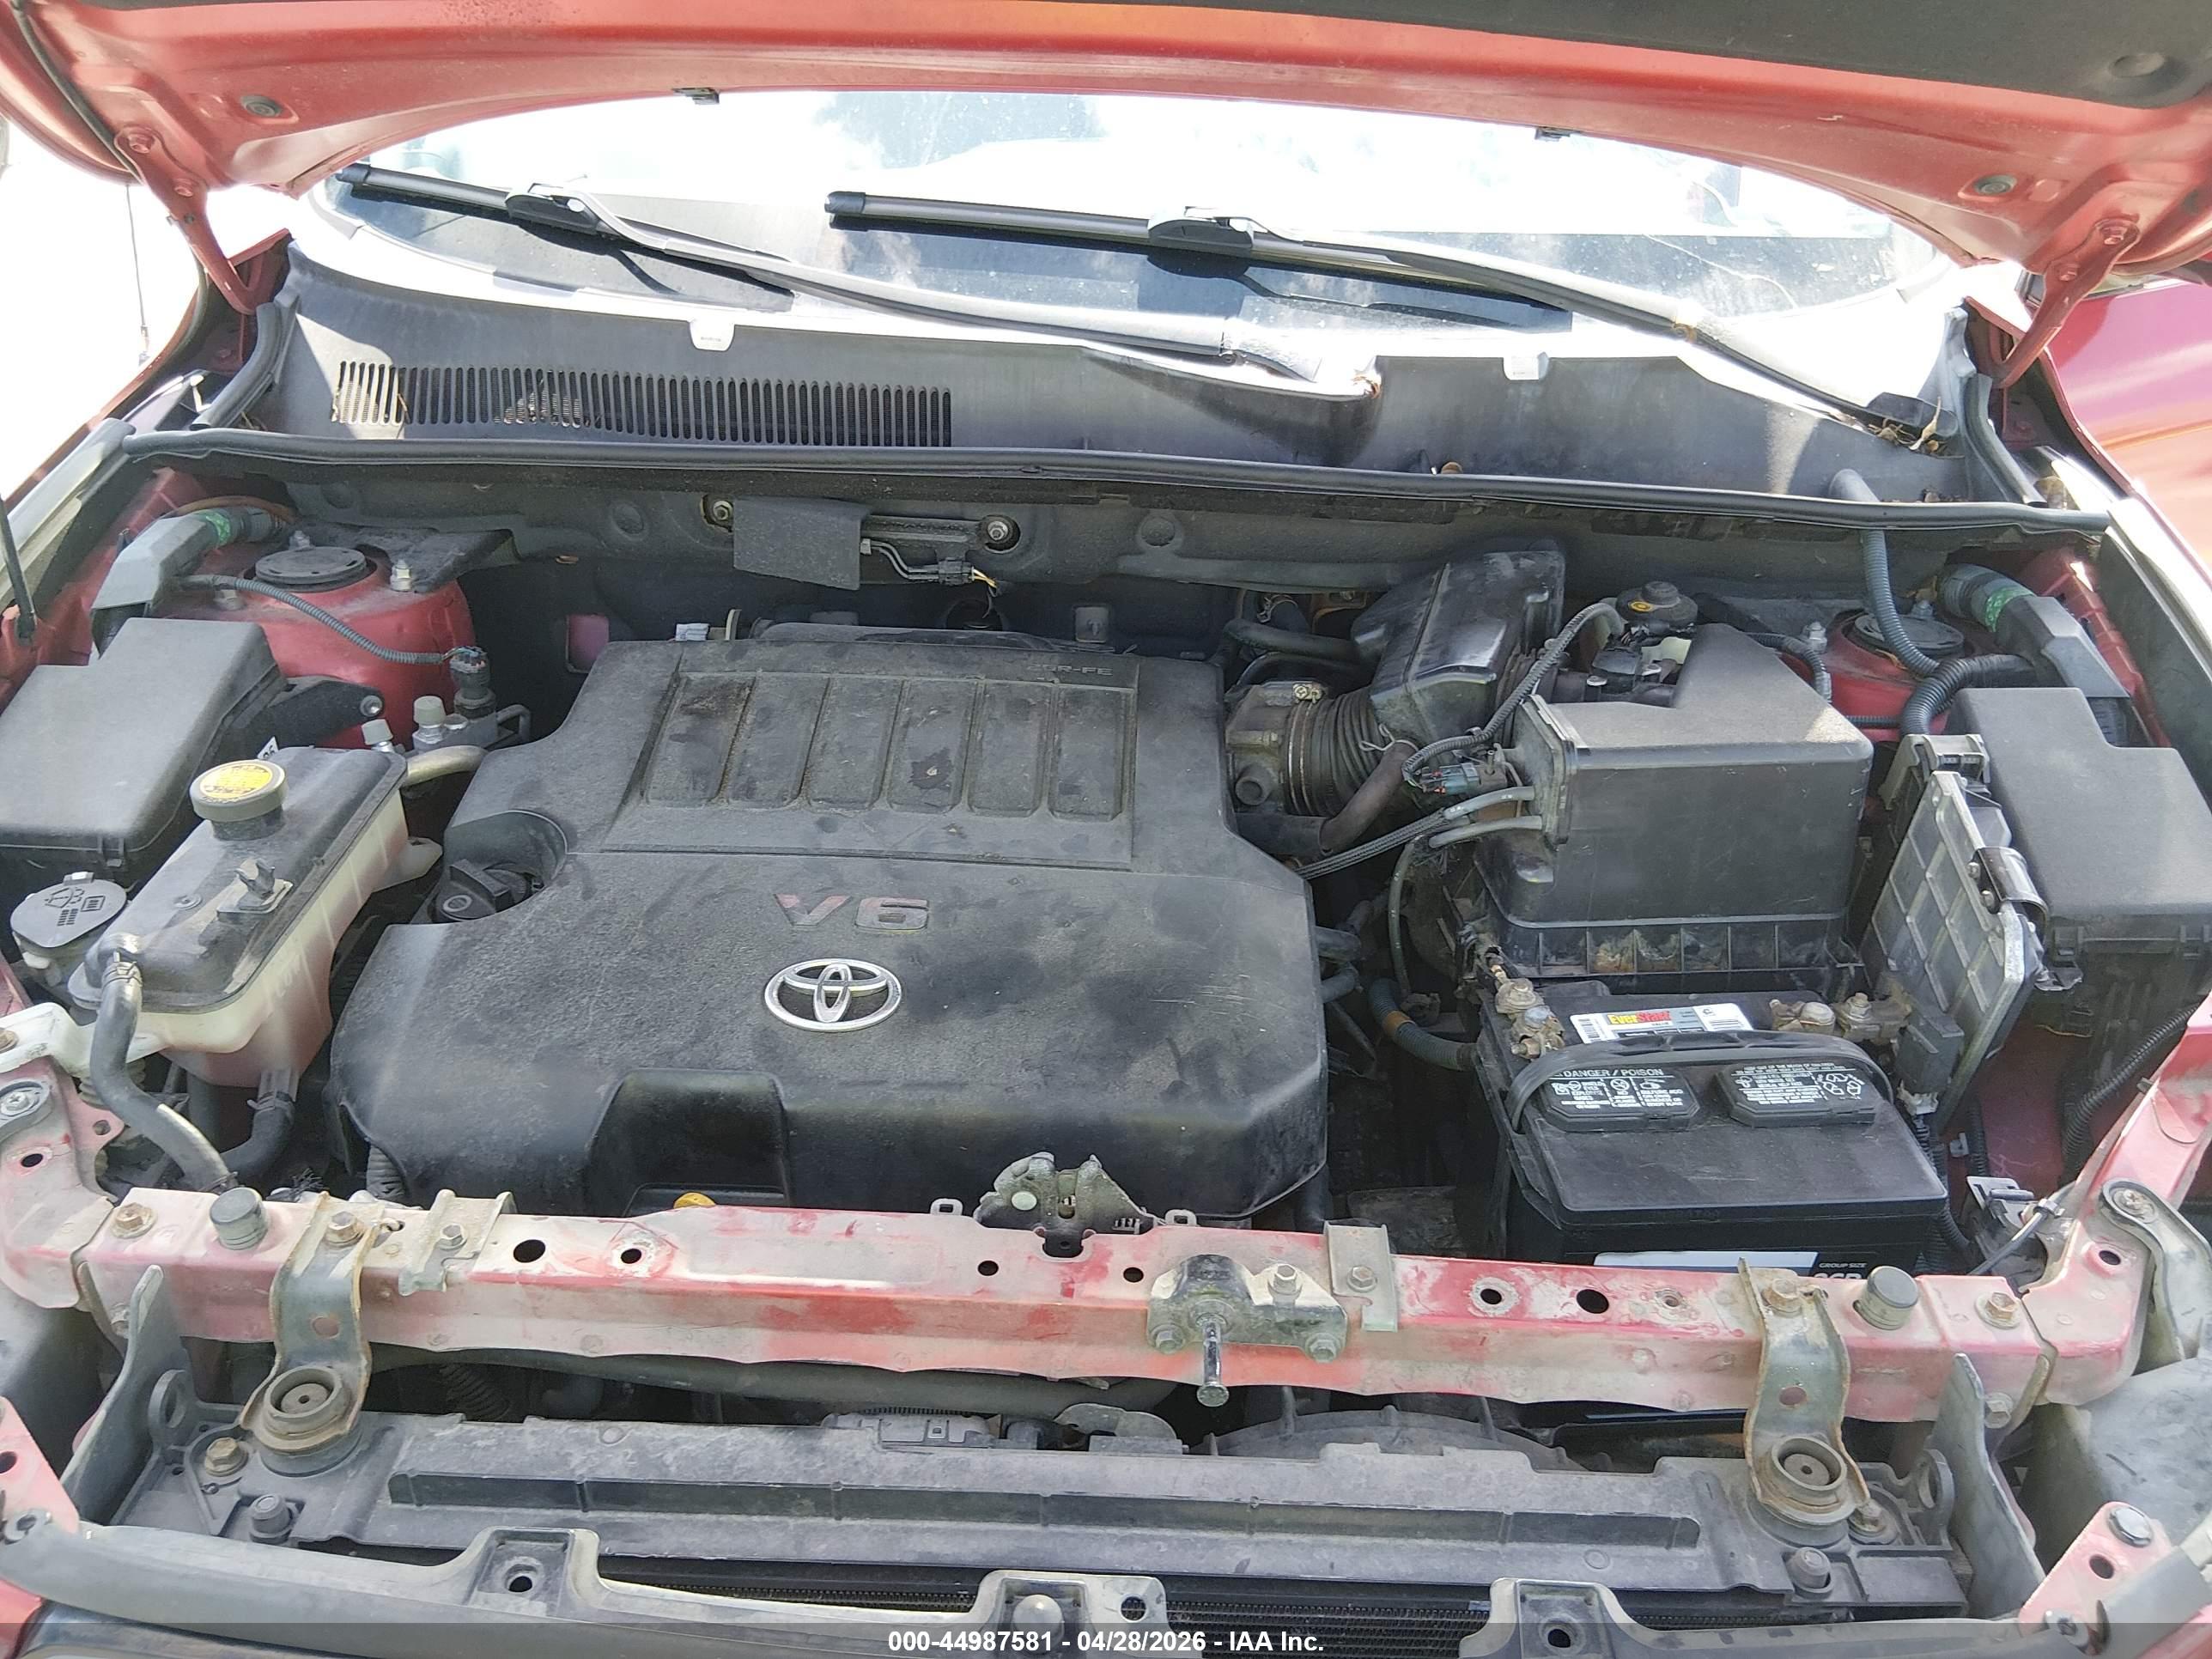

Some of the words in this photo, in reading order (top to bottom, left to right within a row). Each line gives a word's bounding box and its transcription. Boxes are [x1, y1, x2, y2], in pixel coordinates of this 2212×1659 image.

[773, 893, 930, 931] V6
[1564, 1069, 1611, 1078] DANGER
[1621, 1068, 1664, 1077] POISON
